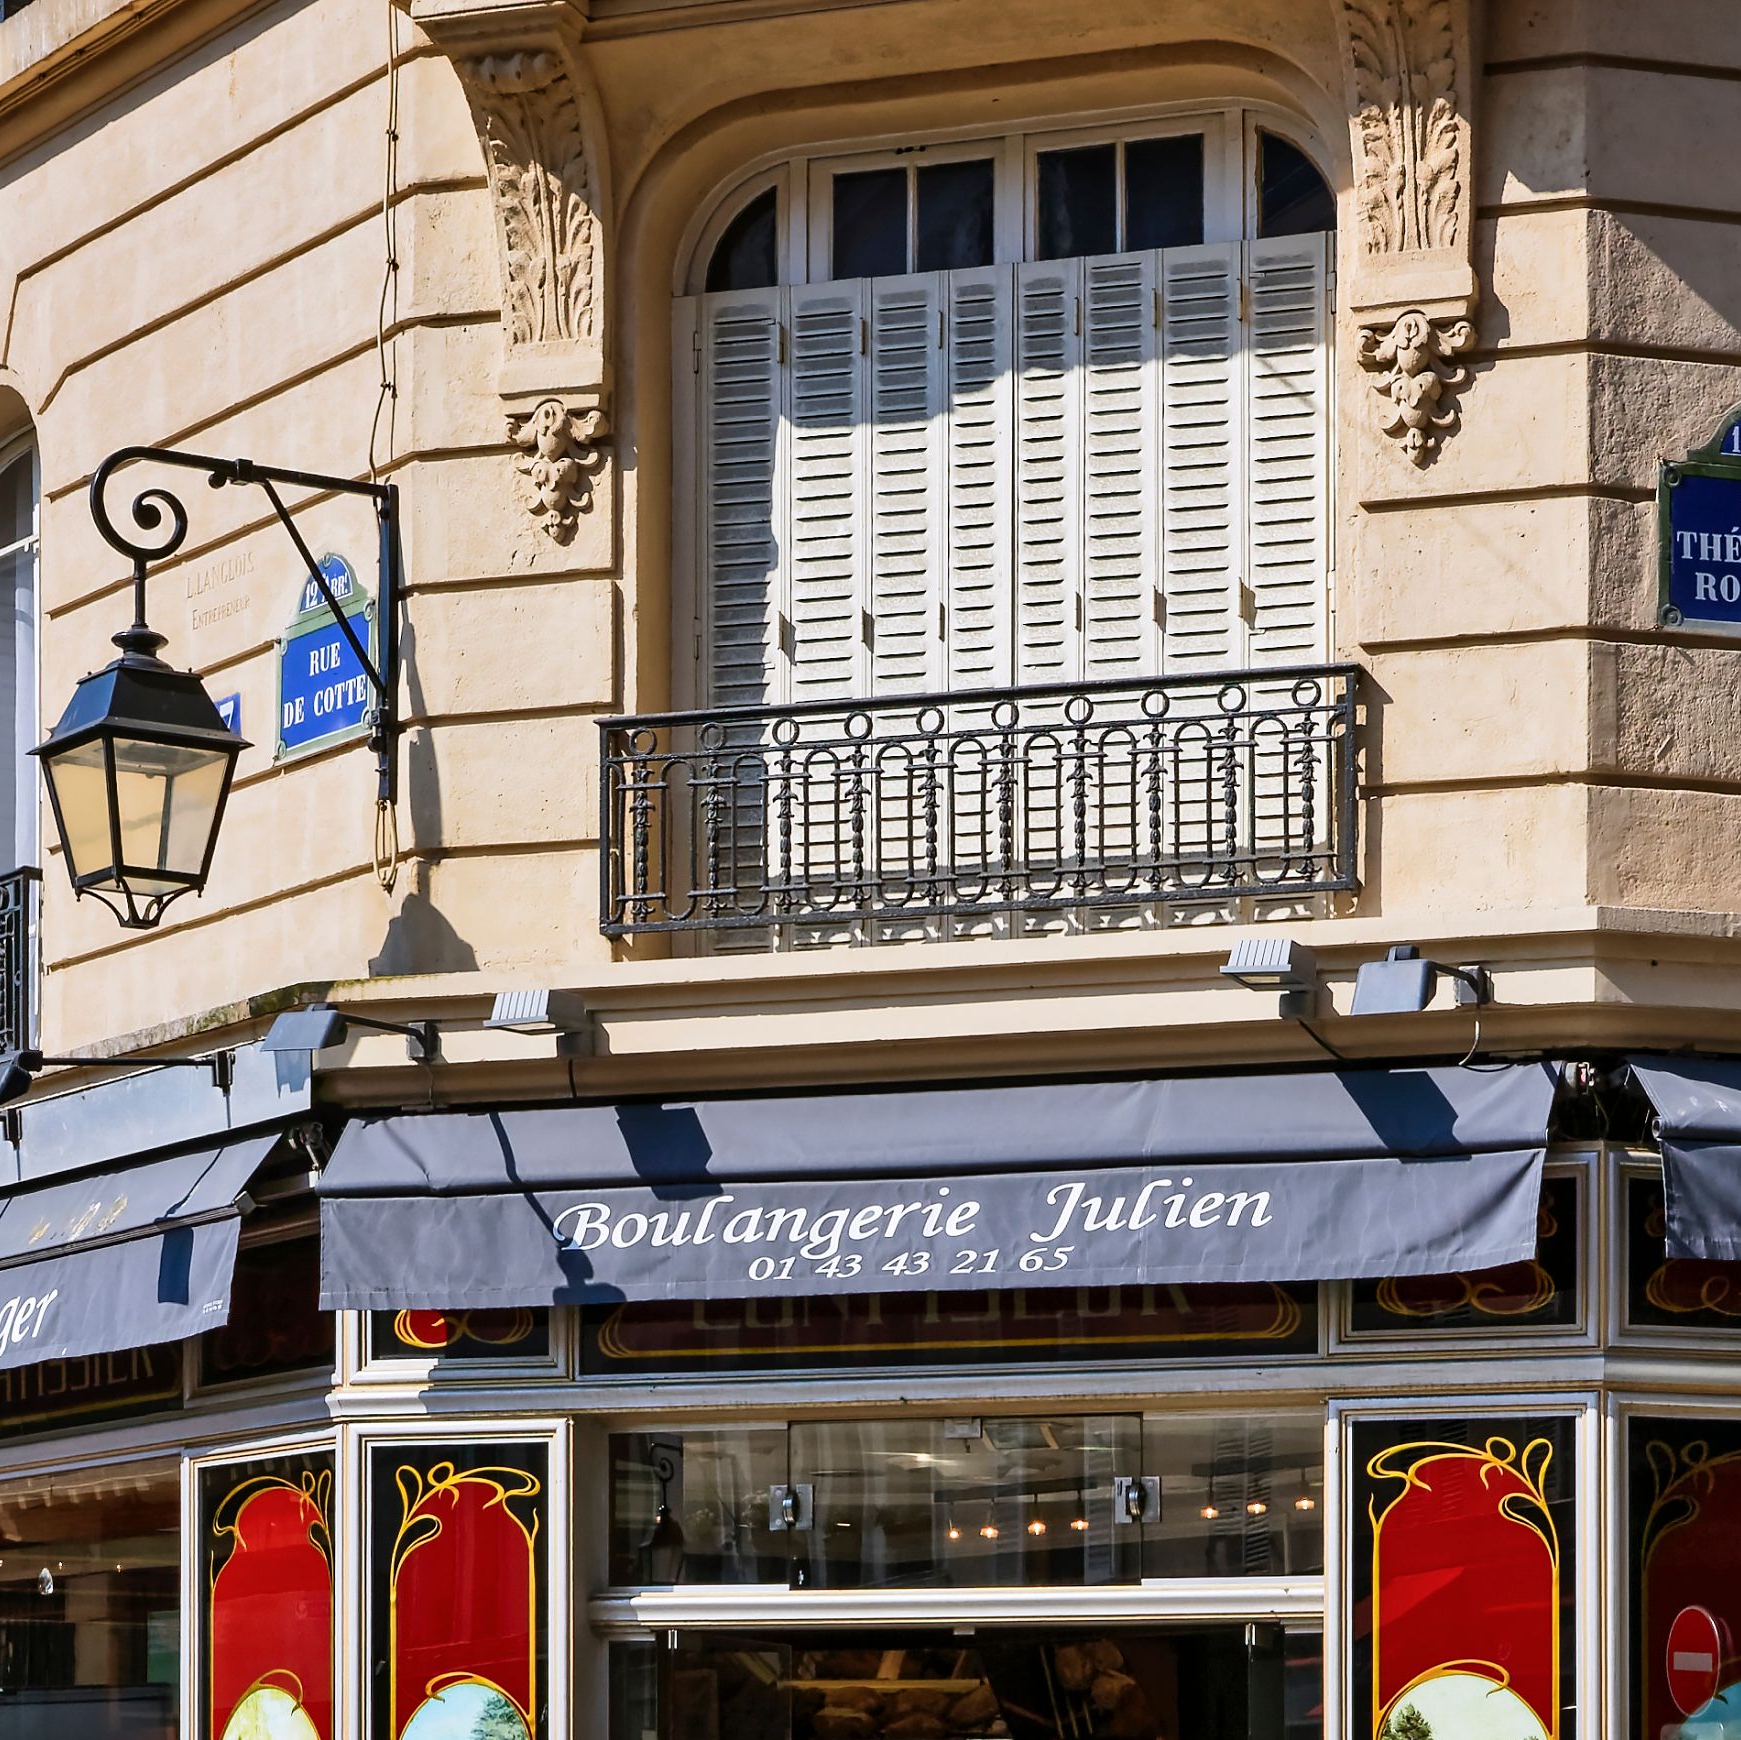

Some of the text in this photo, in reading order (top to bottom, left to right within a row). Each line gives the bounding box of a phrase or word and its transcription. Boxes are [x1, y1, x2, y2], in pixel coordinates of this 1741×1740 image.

[309, 641, 341, 676] RUE
[283, 675, 366, 729] DE COTTE
[553, 1177, 1273, 1260] Boulangerie Julien
[748, 1245, 1075, 1281] 01 43 43 21 65
